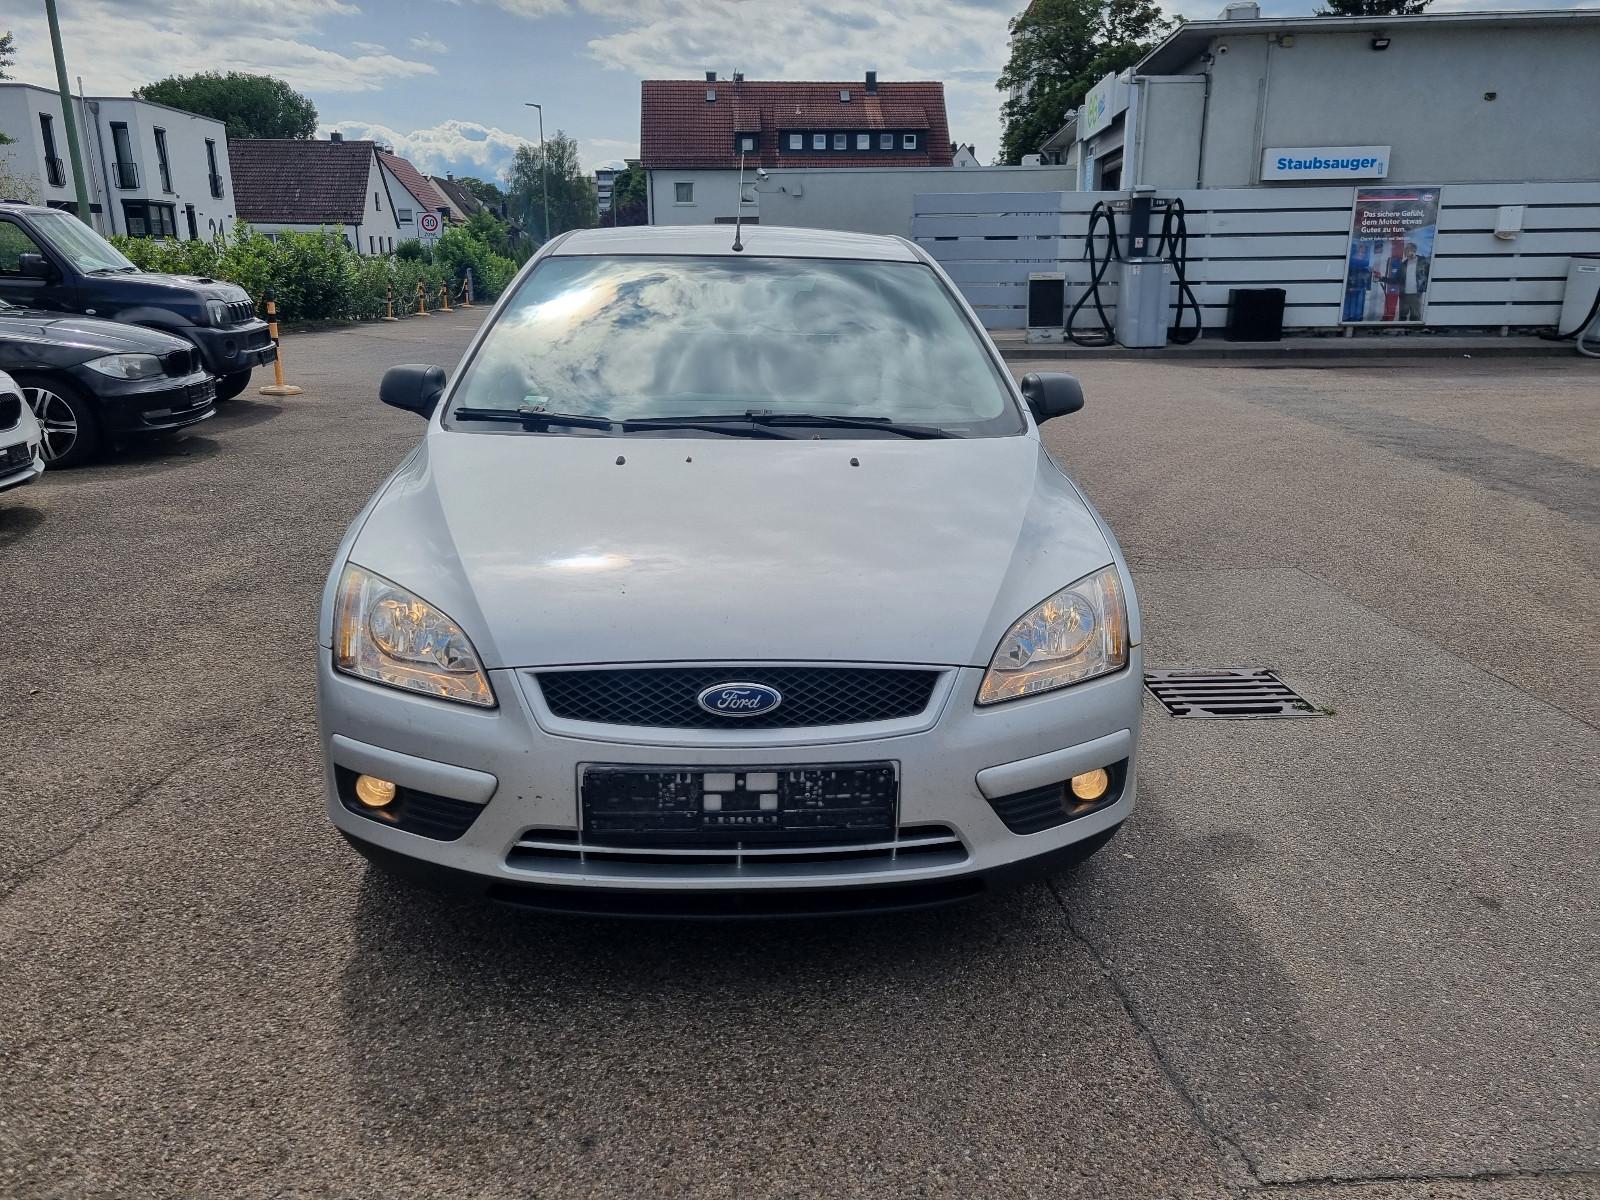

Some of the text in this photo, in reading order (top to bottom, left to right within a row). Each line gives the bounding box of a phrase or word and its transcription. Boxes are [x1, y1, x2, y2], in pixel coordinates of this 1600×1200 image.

[1277, 157, 1377, 170] Staubsauger
[425, 219, 435, 227] 30
[717, 690, 762, 708] Ford
